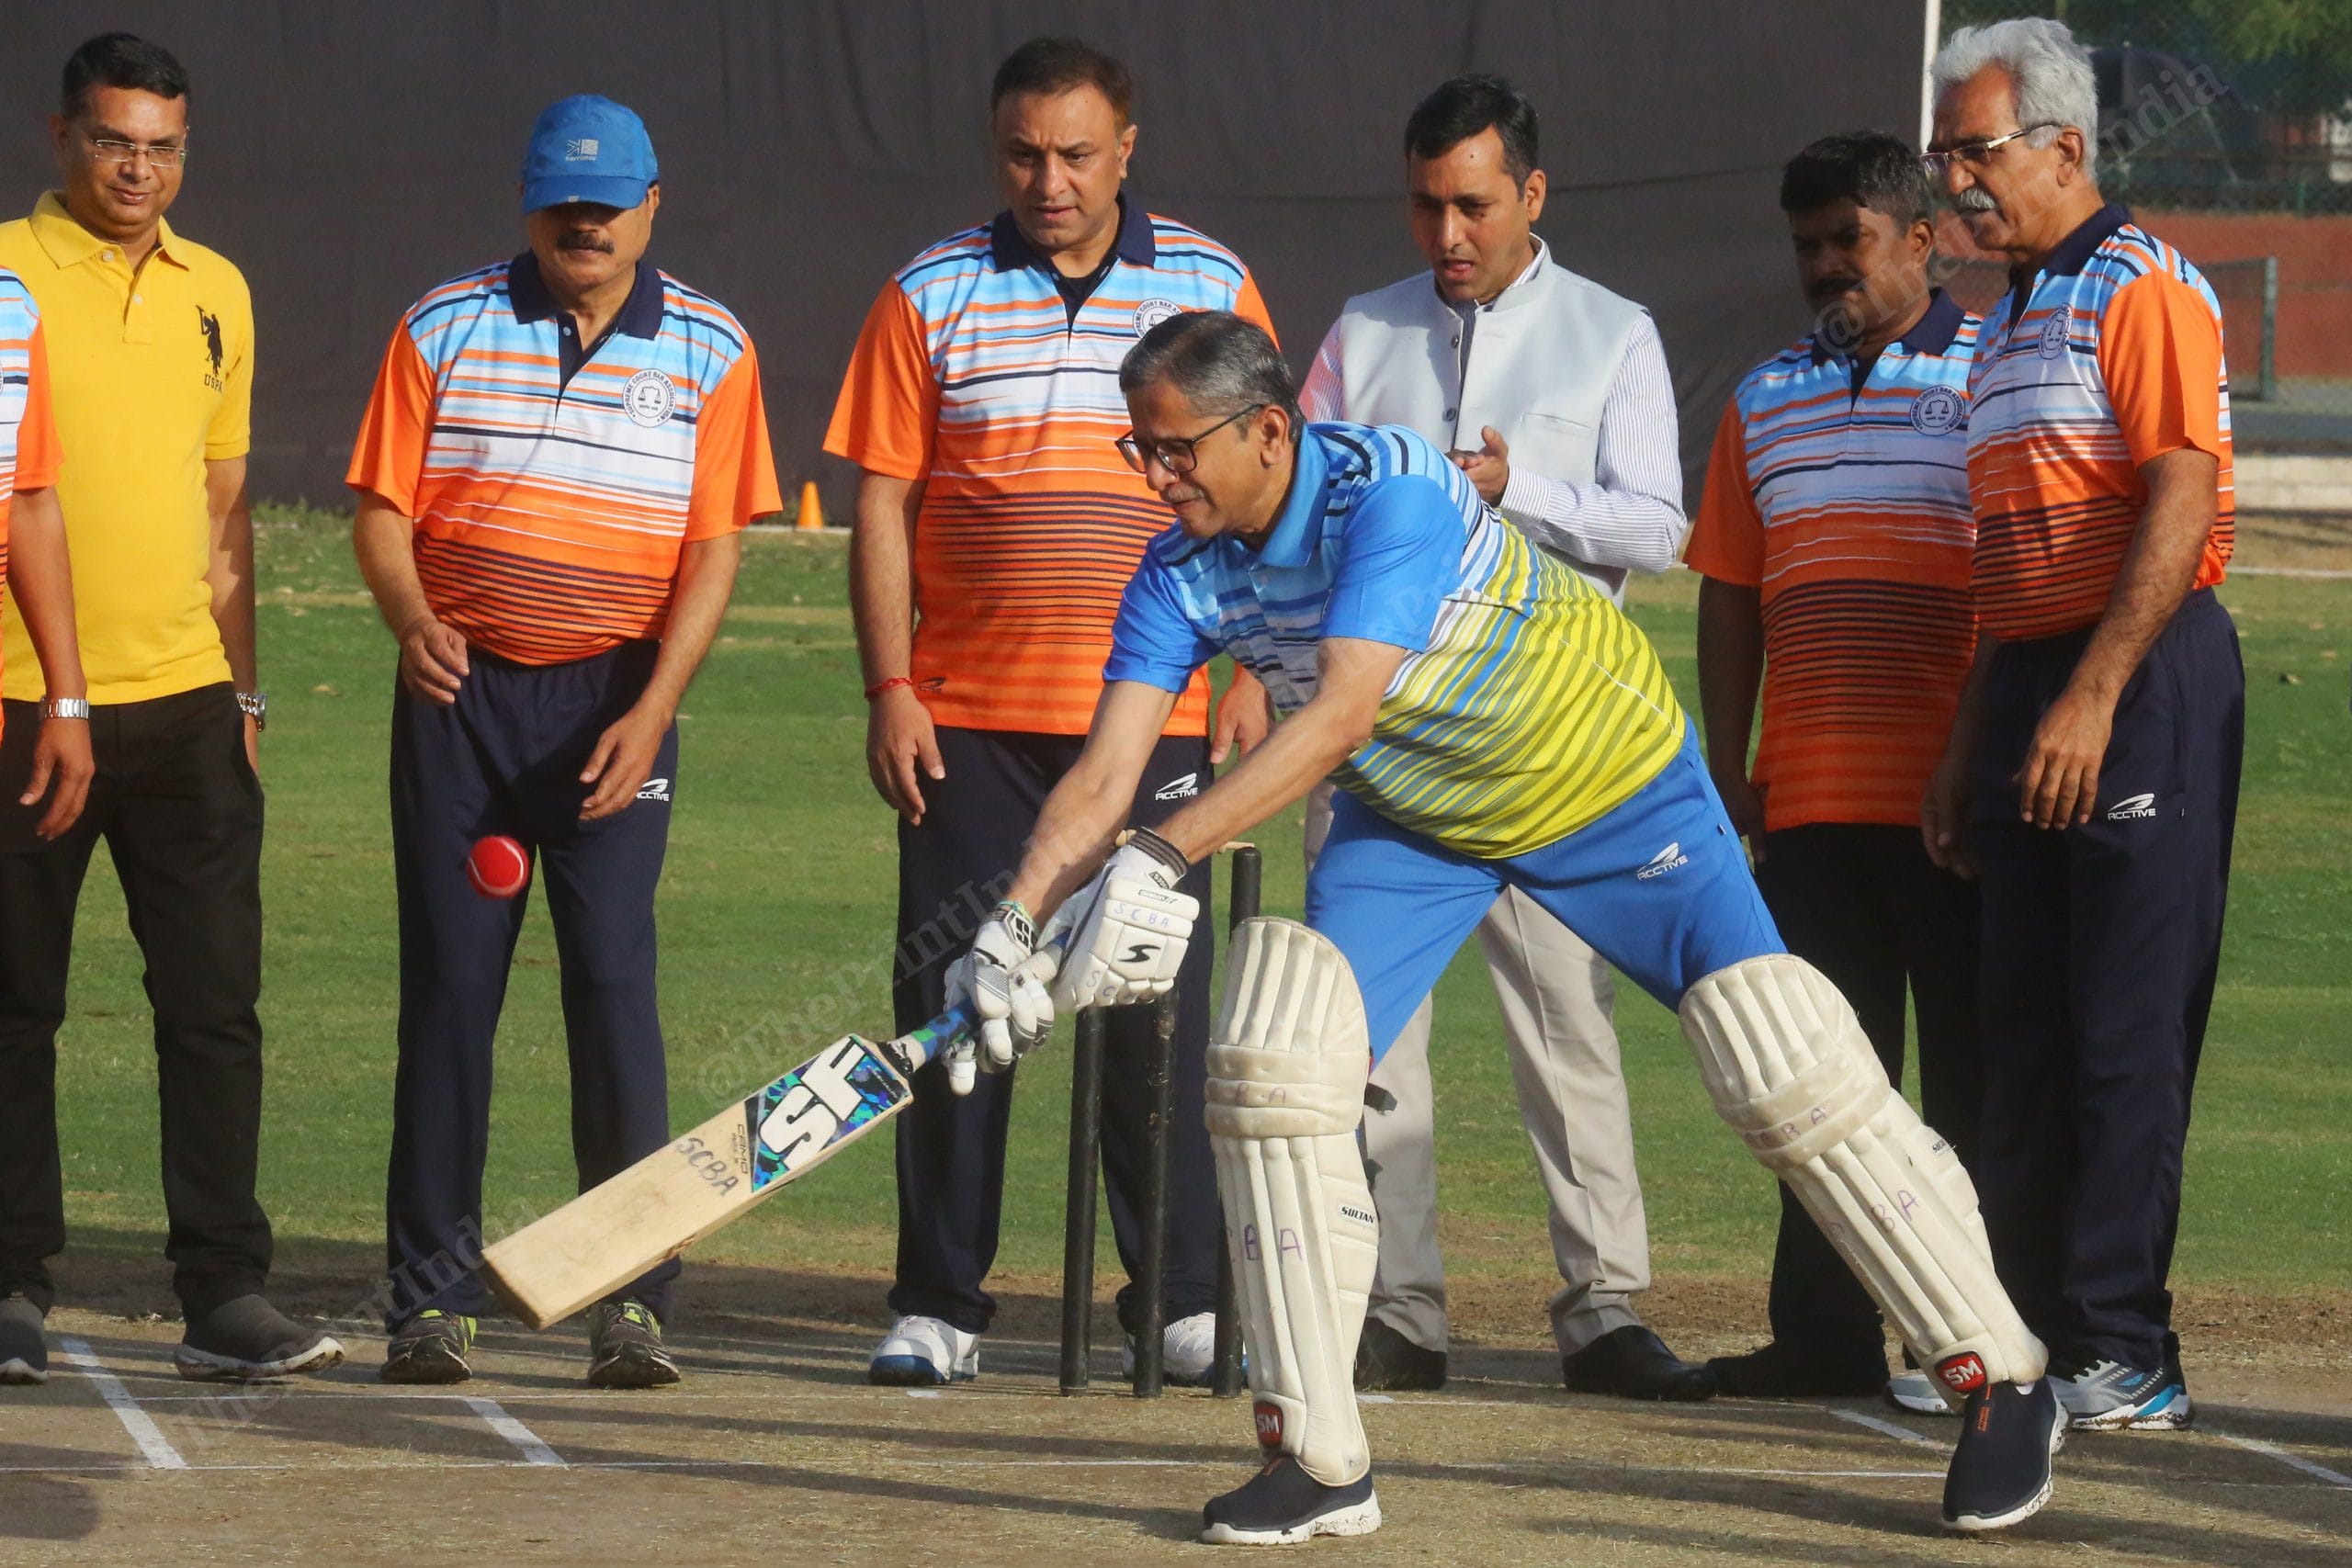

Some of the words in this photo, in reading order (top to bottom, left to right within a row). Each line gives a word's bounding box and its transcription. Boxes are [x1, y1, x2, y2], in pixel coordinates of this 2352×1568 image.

[632, 371, 651, 384] COURT
[653, 372, 665, 381] BAR
[661, 379, 675, 421] ASSOCIATION
[1155, 787, 1198, 801] ACCTIVE
[2108, 808, 2155, 820] ACCTIVE
[1637, 855, 1688, 880] ACCTIVE
[1114, 901, 1169, 927] SCBA
[758, 1035, 865, 1171] SF
[677, 1136, 739, 1196] SCBA
[1340, 1206, 1374, 1224] SULTAN
